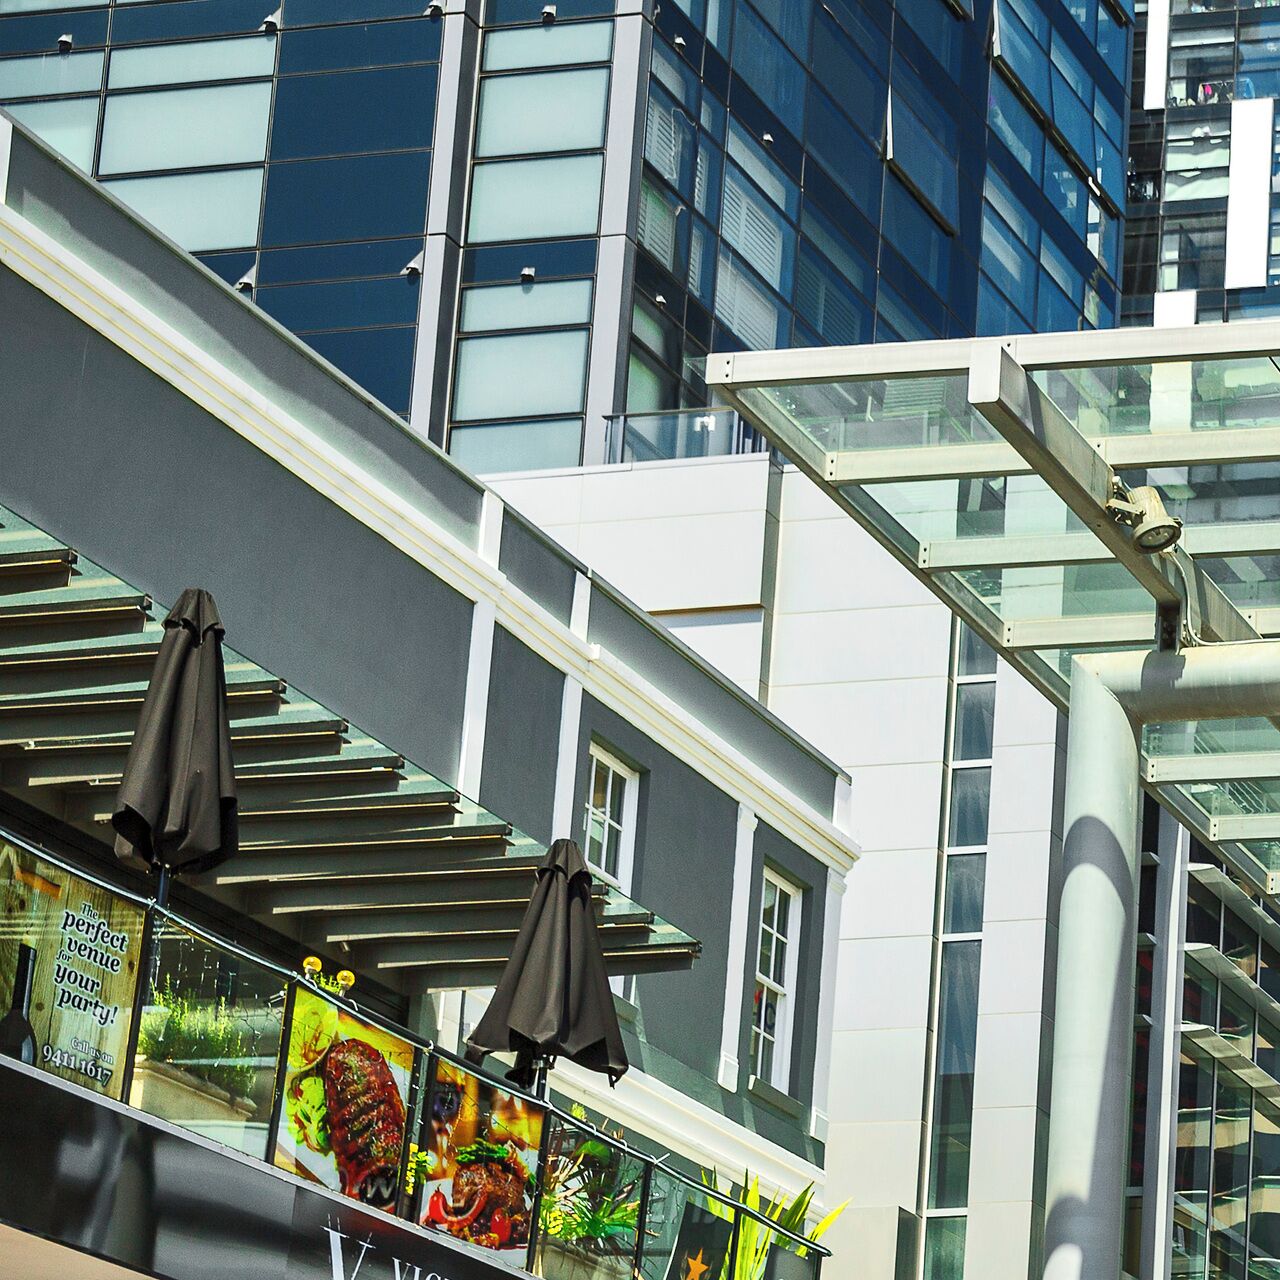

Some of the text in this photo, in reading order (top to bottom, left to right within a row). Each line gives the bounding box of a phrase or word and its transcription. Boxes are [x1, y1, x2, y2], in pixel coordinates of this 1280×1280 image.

[81, 902, 98, 920] The
[62, 911, 128, 953] perfect
[55, 949, 73, 963] for
[67, 936, 121, 973] venue
[54, 964, 101, 994] your
[57, 985, 118, 1027] party!
[42, 1044, 113, 1087] 9411 1617
[71, 1037, 114, 1065] Call us on
